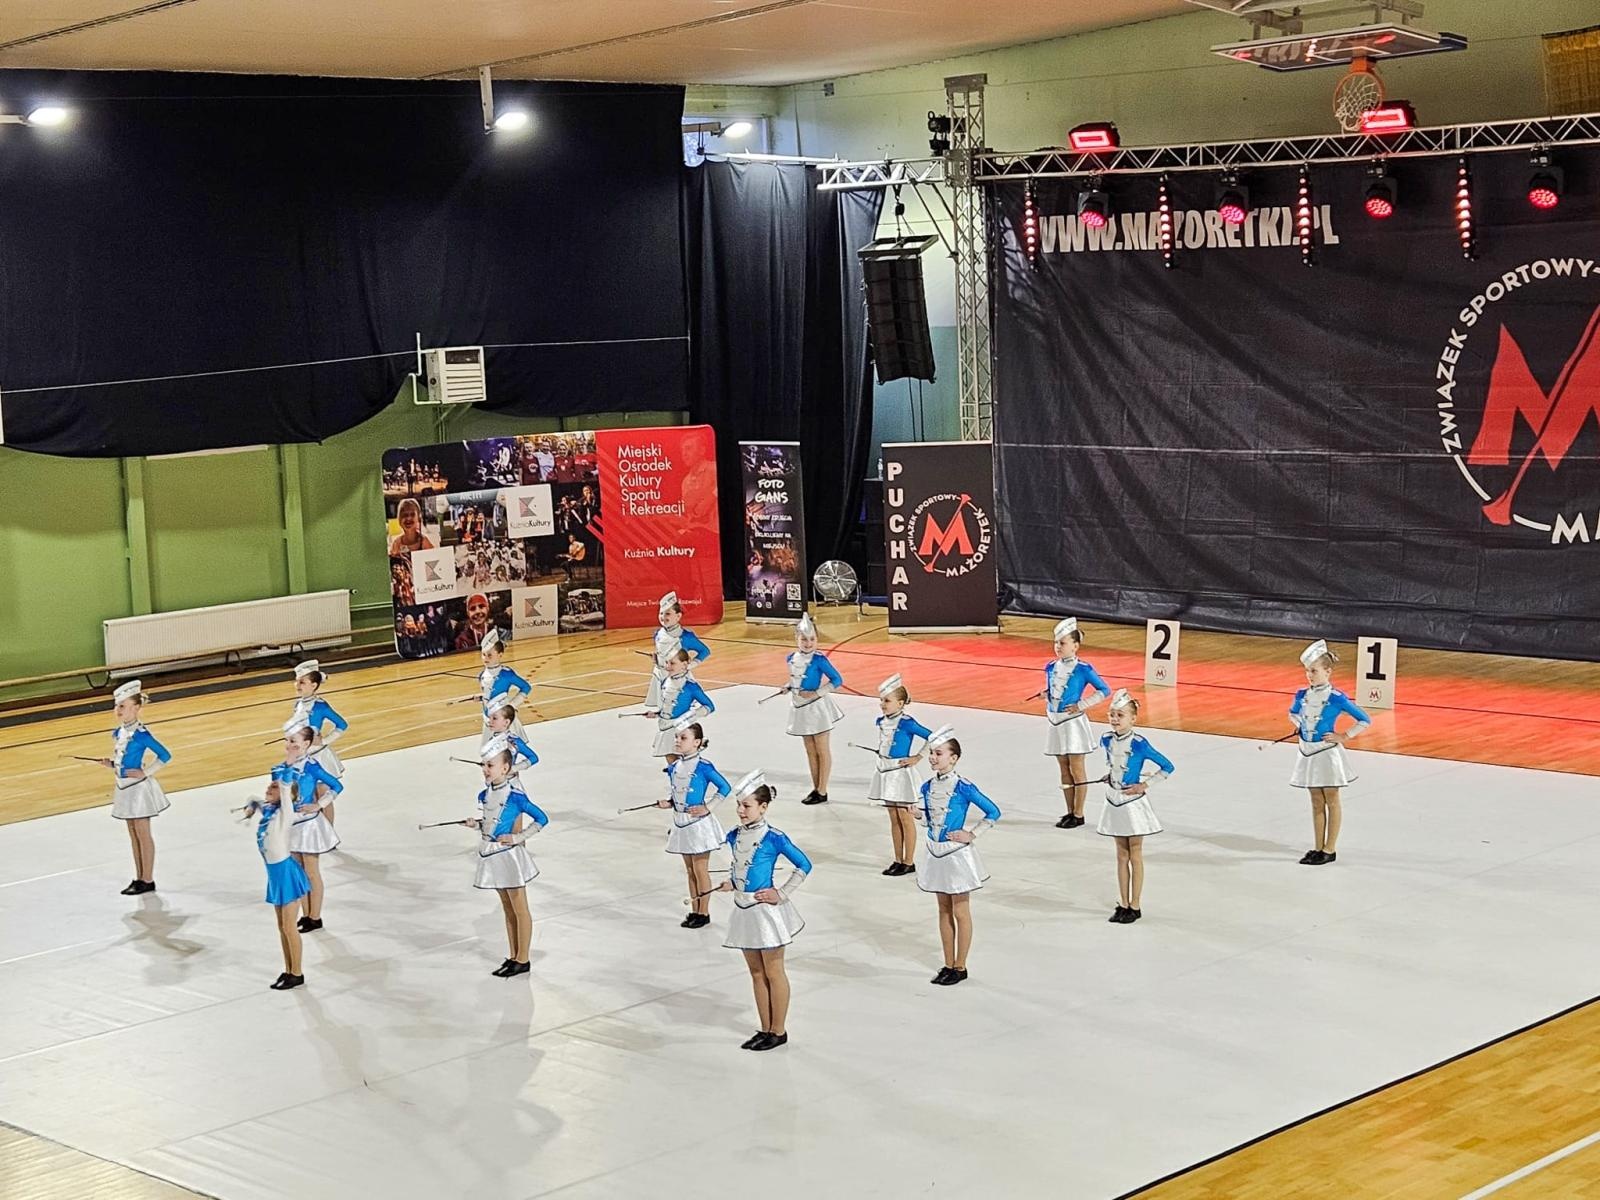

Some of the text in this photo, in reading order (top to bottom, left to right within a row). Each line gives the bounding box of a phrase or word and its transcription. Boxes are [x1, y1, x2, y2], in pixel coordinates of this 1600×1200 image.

[1436, 257, 1595, 453] ZWIĄZEK SPORTOWY
[618, 442, 662, 461] Miejski
[618, 456, 673, 473] Ośrodek
[619, 472, 662, 490] Kultury
[757, 478, 785, 489] FOTO
[621, 488, 661, 505] Sportu
[754, 491, 789, 504] GANS
[915, 493, 957, 515] SPORTOWY
[621, 500, 685, 517] i Rekreacji
[886, 461, 910, 612] PUCHAR
[945, 507, 991, 578] MAŻORETEK
[624, 545, 695, 559] Kuźnia Kultury
[1152, 623, 1171, 660] 2
[1366, 642, 1386, 681] 1
